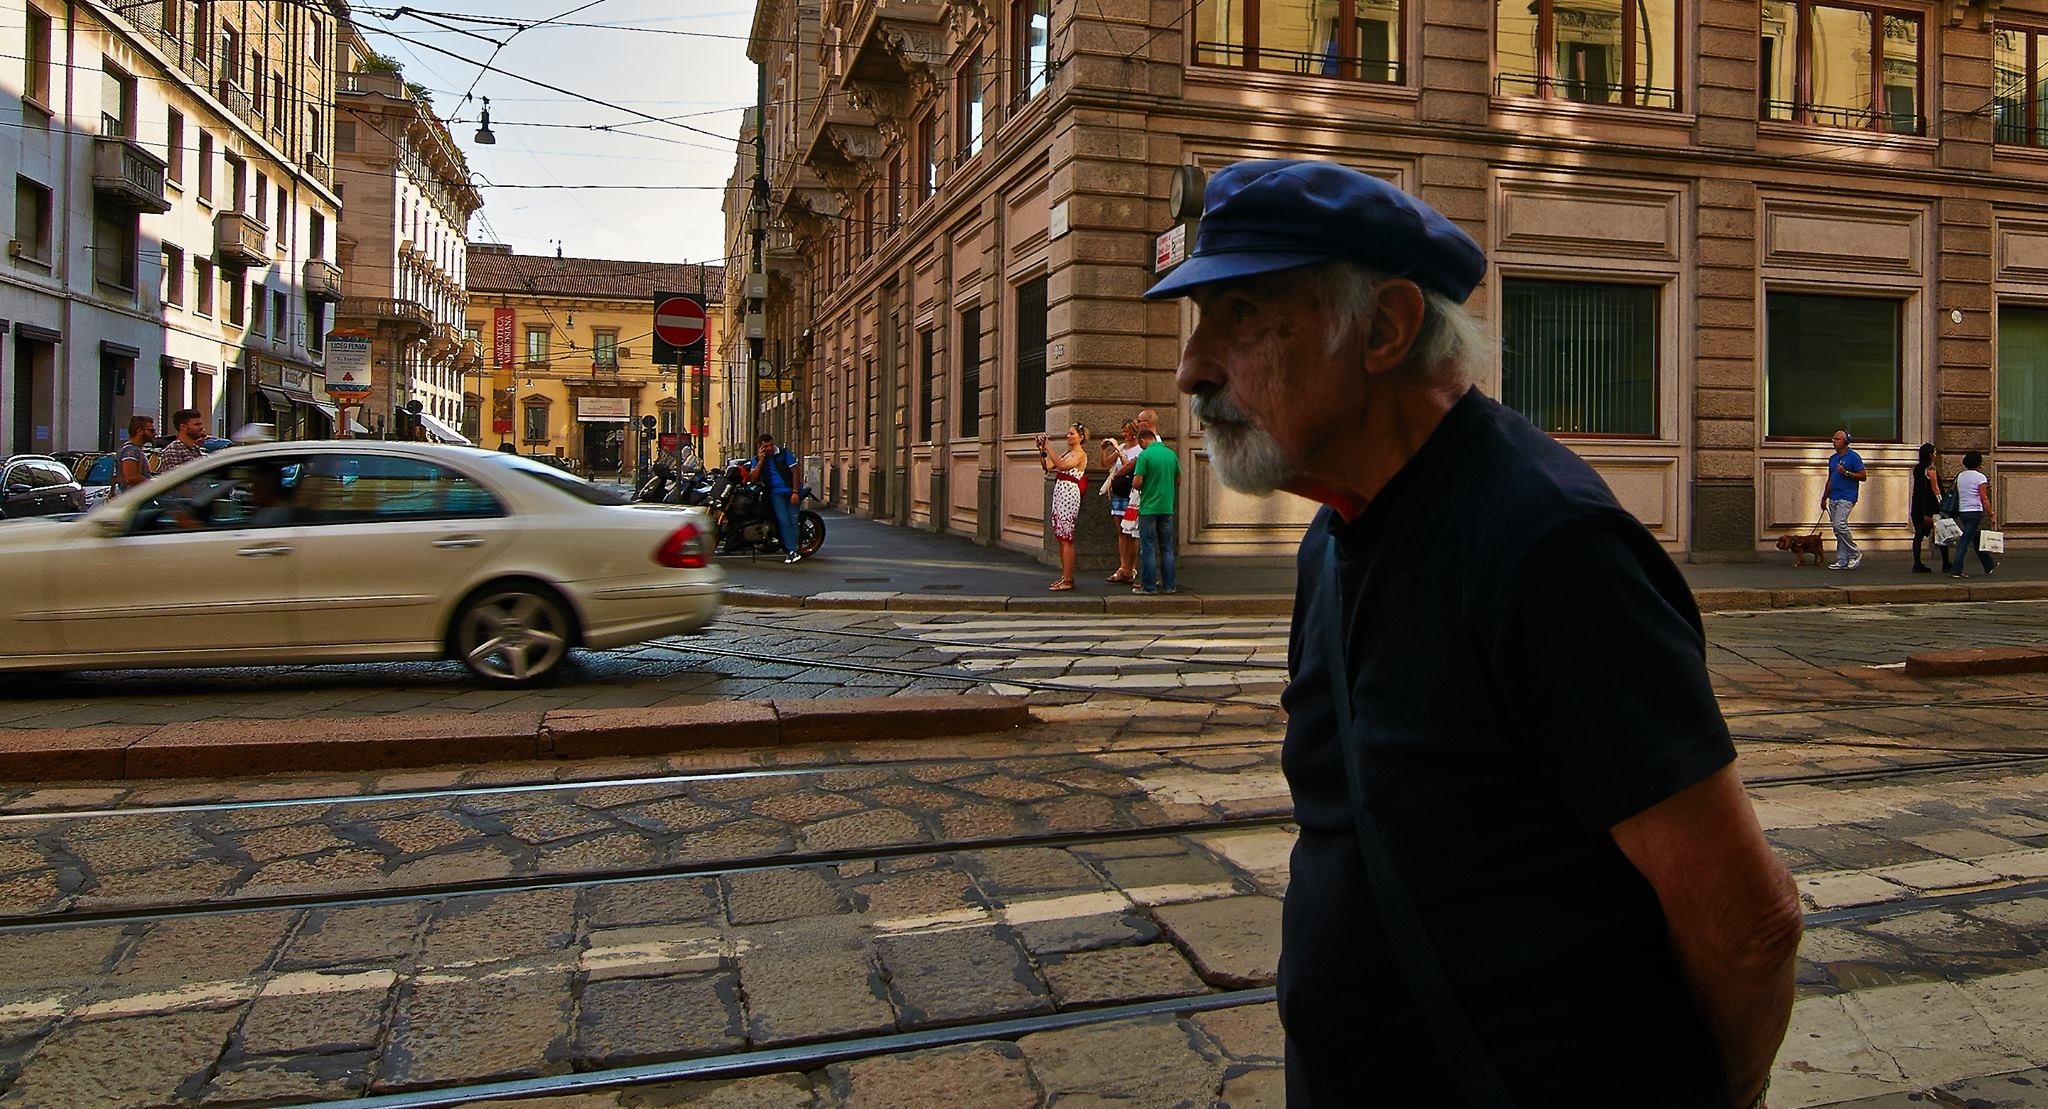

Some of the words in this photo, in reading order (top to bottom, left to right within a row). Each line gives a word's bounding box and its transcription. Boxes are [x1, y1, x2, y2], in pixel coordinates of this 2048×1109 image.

[330, 342, 348, 350] LICEO
[348, 342, 367, 350] FERMI
[504, 315, 512, 364] AMBROSIANA
